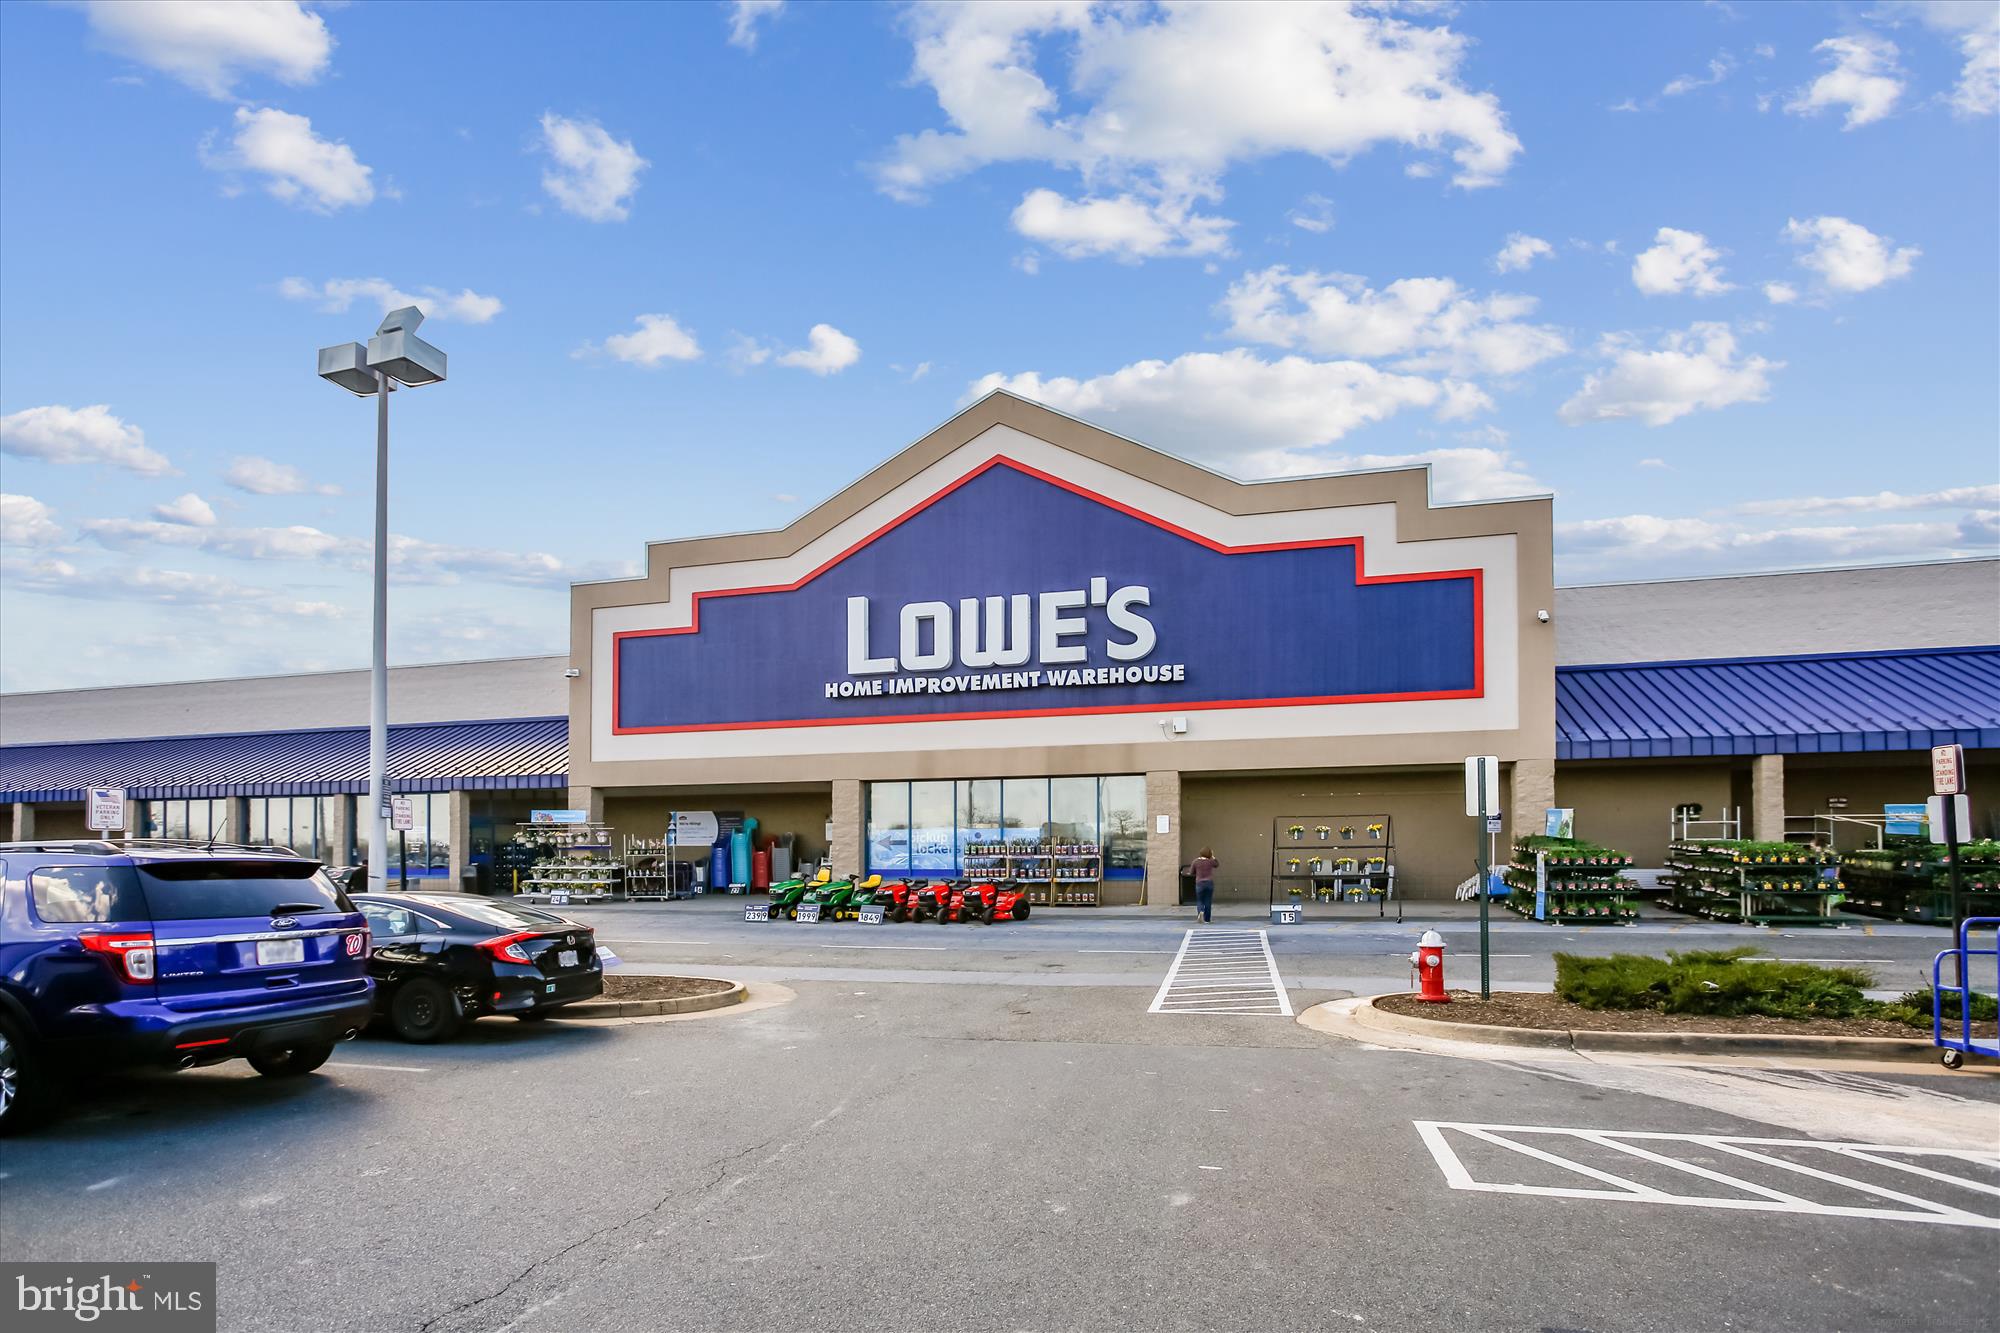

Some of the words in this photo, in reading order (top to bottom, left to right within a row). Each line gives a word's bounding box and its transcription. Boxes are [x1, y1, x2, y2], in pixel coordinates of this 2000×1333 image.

[847, 577, 1157, 675] LOWE'S
[825, 680, 882, 698] HOME
[889, 671, 1041, 695] IMPROVEMENT
[1046, 664, 1185, 687] WAREHOUSE
[746, 911, 768, 920] 2399
[799, 912, 816, 920] 1999
[860, 913, 880, 922] 1849
[1282, 913, 1295, 922] 15
